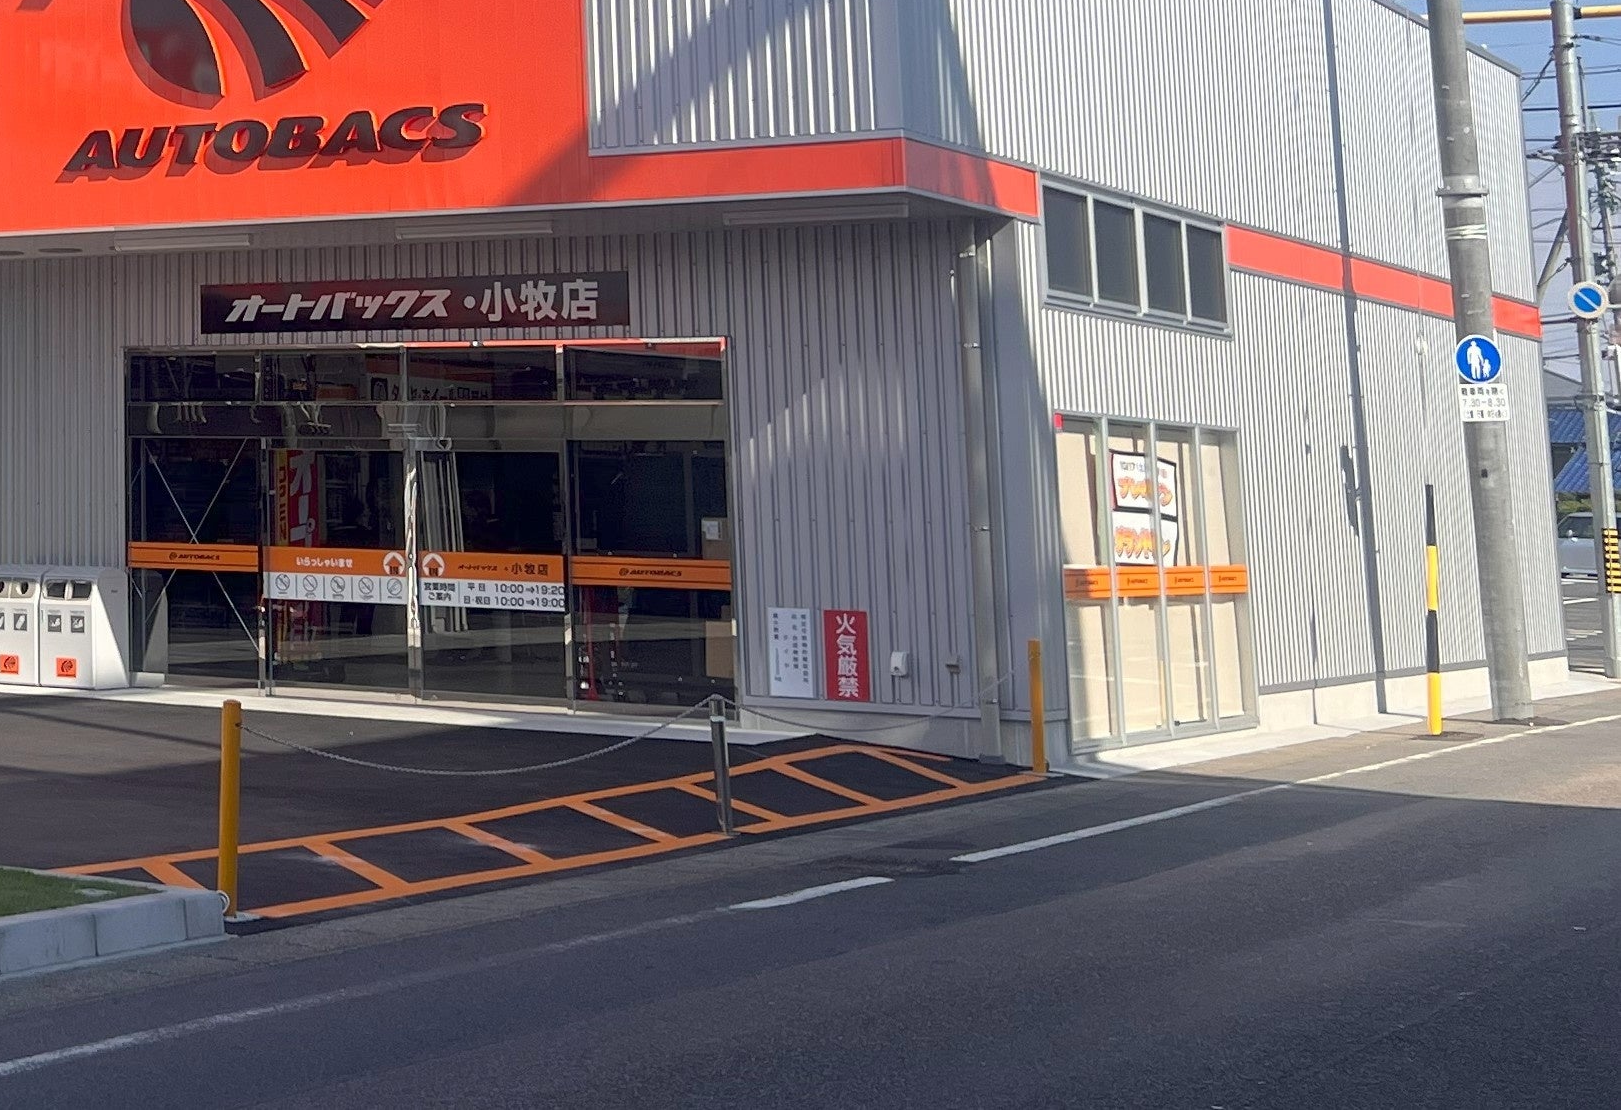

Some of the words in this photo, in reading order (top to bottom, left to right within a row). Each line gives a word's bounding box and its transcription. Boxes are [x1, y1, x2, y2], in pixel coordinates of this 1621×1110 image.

[63, 103, 487, 173] AUTOBACS
[835, 612, 859, 698] 火気厳禁
